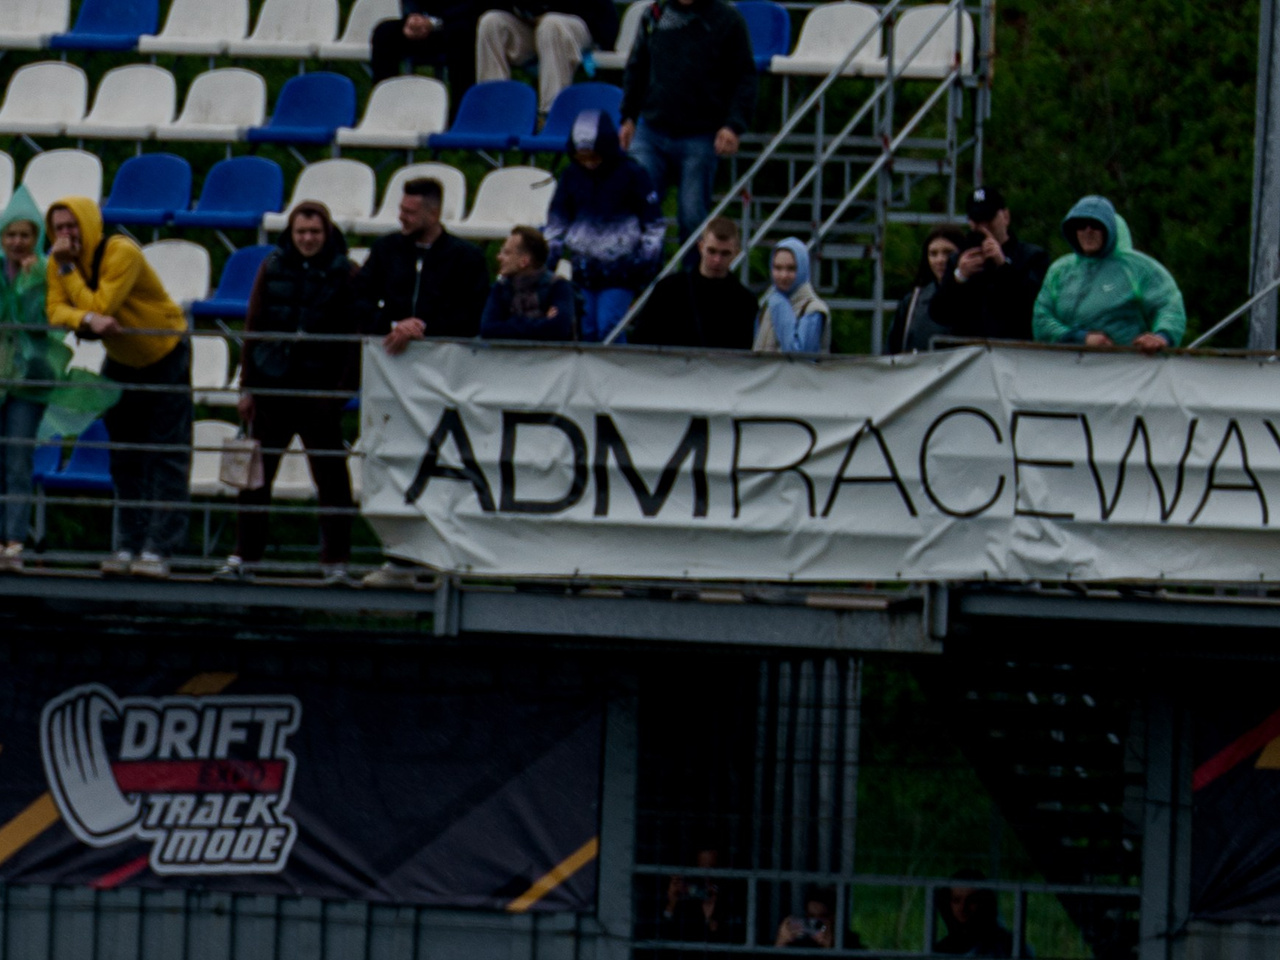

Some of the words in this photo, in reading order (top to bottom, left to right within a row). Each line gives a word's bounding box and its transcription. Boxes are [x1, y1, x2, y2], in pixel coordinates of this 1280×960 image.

[119, 706, 290, 760] DRIFT
[146, 793, 279, 827] TRACK
[163, 828, 288, 862] MODE
